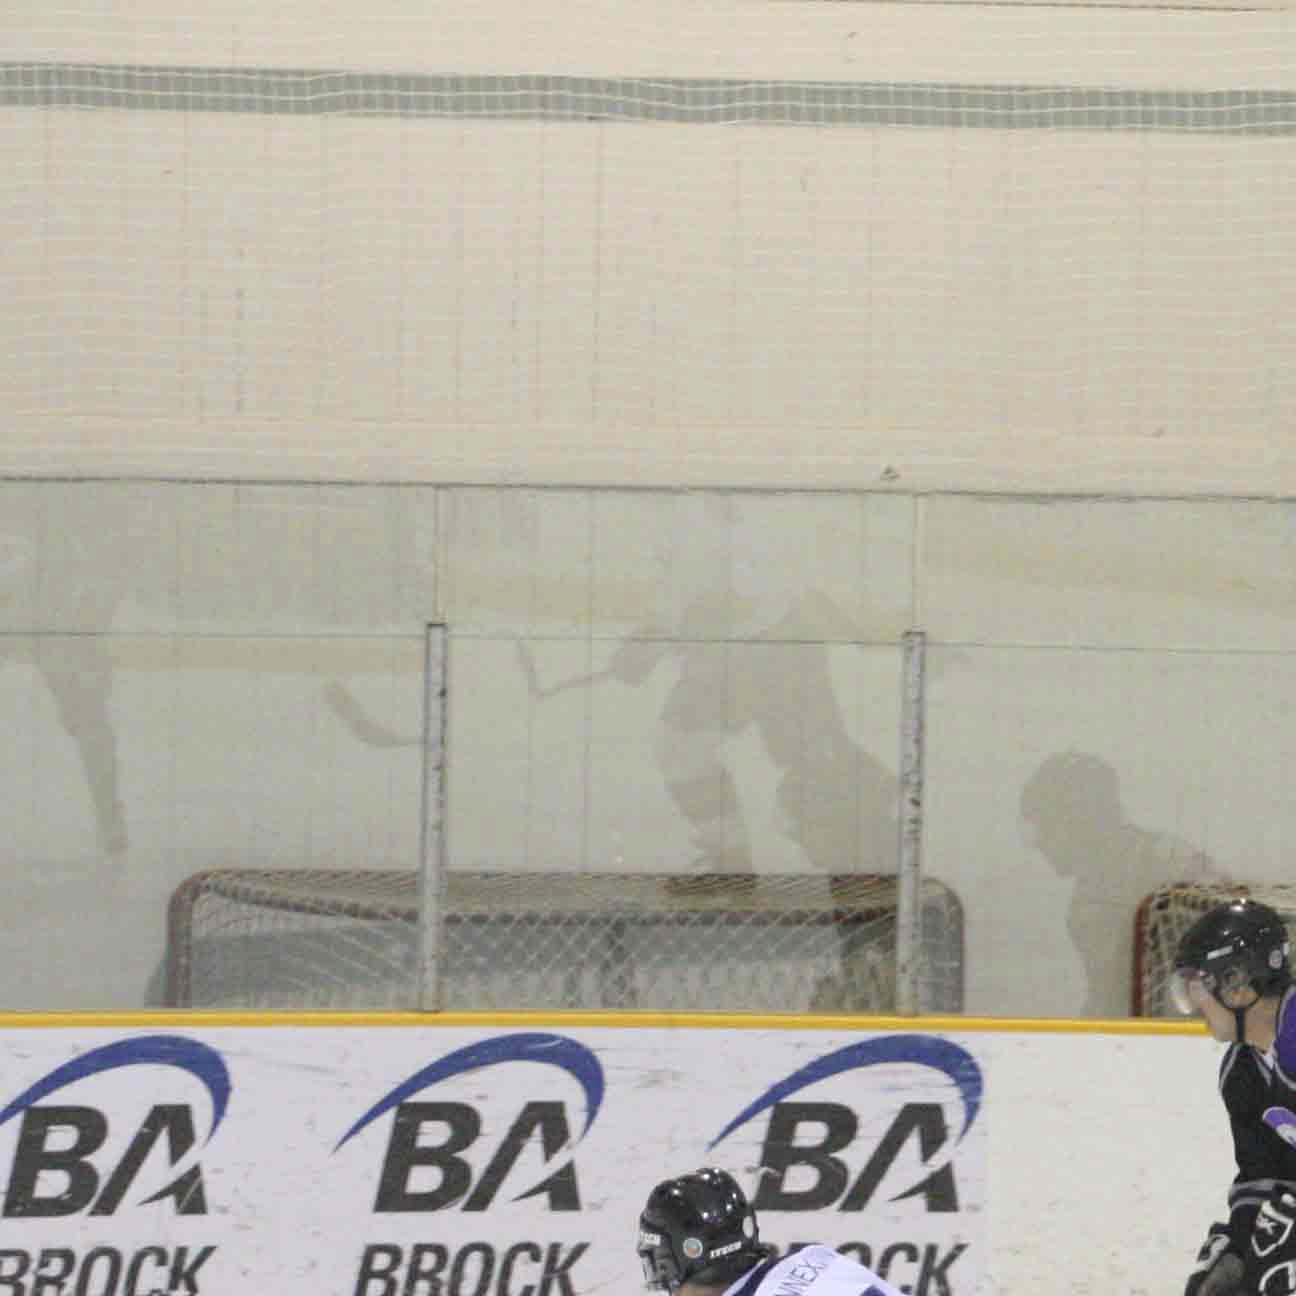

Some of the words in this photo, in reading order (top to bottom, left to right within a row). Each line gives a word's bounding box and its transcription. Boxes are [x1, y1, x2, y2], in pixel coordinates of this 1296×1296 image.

[4, 1103, 208, 1217] BA
[374, 1100, 584, 1214] BA
[752, 1100, 960, 1213] BA
